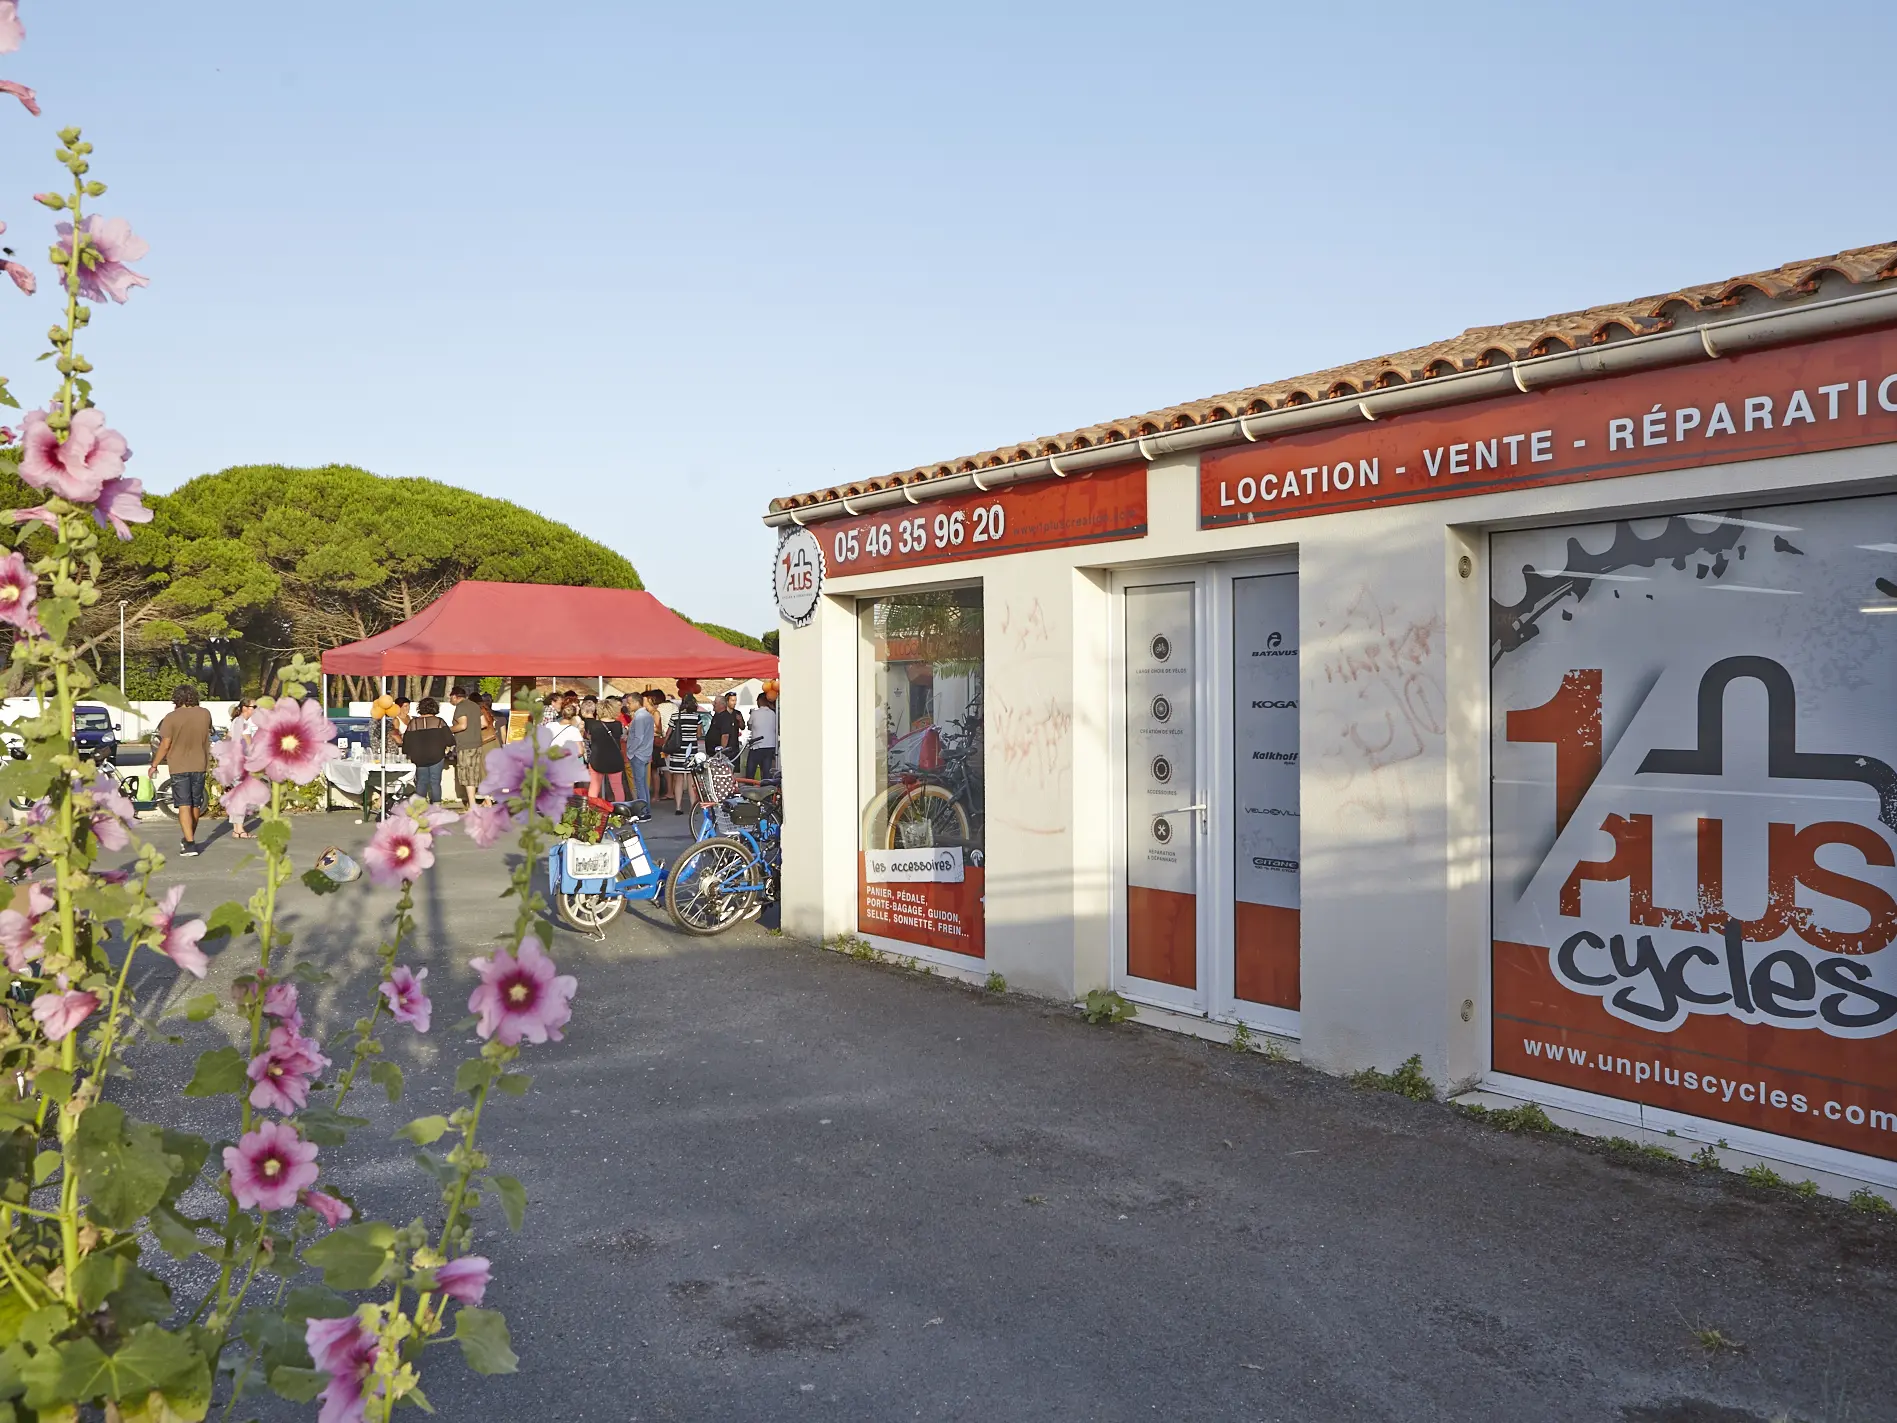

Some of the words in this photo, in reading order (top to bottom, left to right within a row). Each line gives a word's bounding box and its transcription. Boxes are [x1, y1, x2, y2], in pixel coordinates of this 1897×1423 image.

[1220, 457, 1380, 507] LOCATION
[1395, 466, 1406, 475] -
[1422, 429, 1553, 478] VENTE
[1573, 439, 1586, 448] -
[834, 529, 860, 563] 05
[865, 523, 892, 557] 46
[898, 517, 927, 553] 35
[934, 510, 966, 549] 96
[972, 503, 1005, 543] 20
[1252, 649, 1299, 657] BATAVUS
[1251, 700, 1298, 709] KOGA
[1252, 751, 1299, 761] Kalkhoff
[872, 859, 887, 874] les
[891, 859, 953, 874] accessoires
[866, 885, 895, 900] PANIER,
[896, 890, 928, 907] PÉDALE,
[866, 897, 926, 918] PORTE-BAGAGE,
[927, 908, 961, 925] GUIDON,
[866, 908, 891, 923] SELLE,
[893, 914, 936, 932] SONNETTE,
[937, 922, 970, 938] FREIN...
[1558, 918, 1897, 1027] cycles
[1523, 1037, 1897, 1134] www.unpluscycles.com
